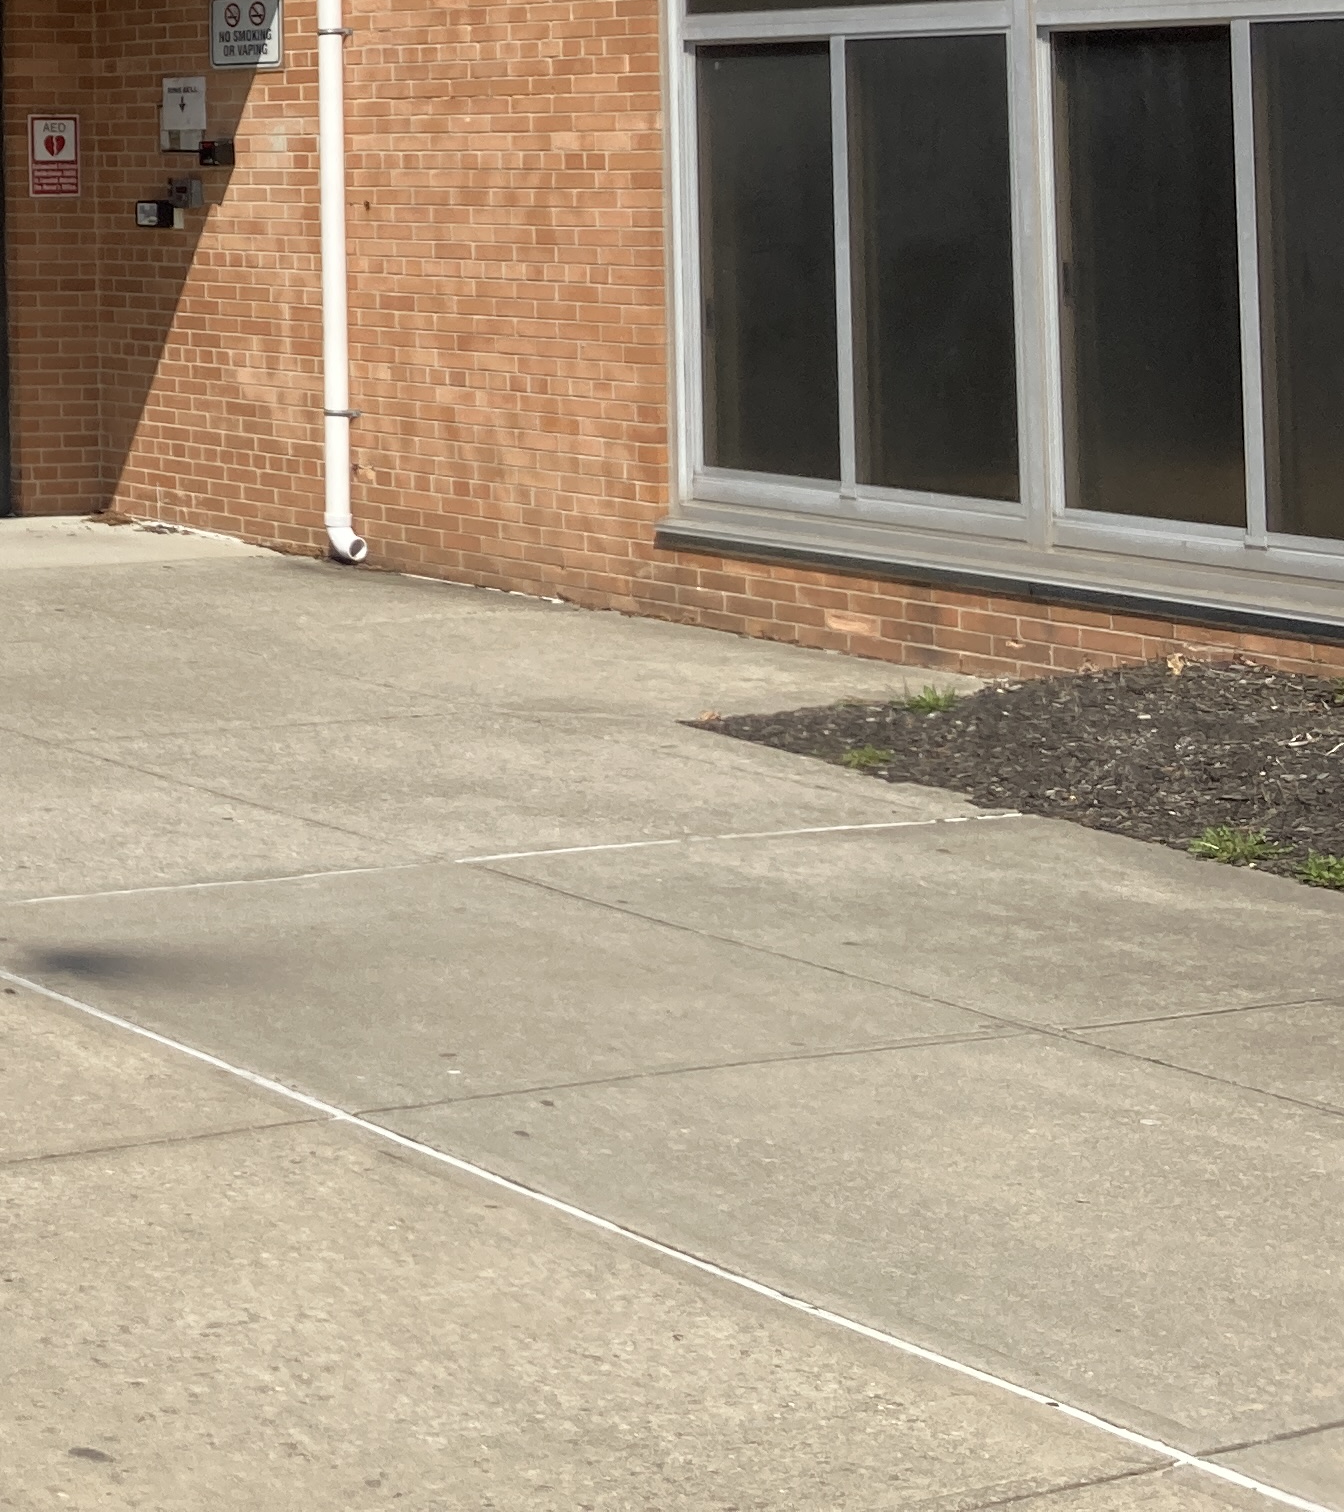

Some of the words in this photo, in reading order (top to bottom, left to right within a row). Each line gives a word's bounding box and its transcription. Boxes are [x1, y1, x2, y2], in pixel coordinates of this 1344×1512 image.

[219, 30, 231, 43] NO
[233, 28, 272, 42] SMOKING
[223, 45, 235, 57] OR
[237, 43, 269, 56] VAPING
[43, 121, 66, 133] AED
